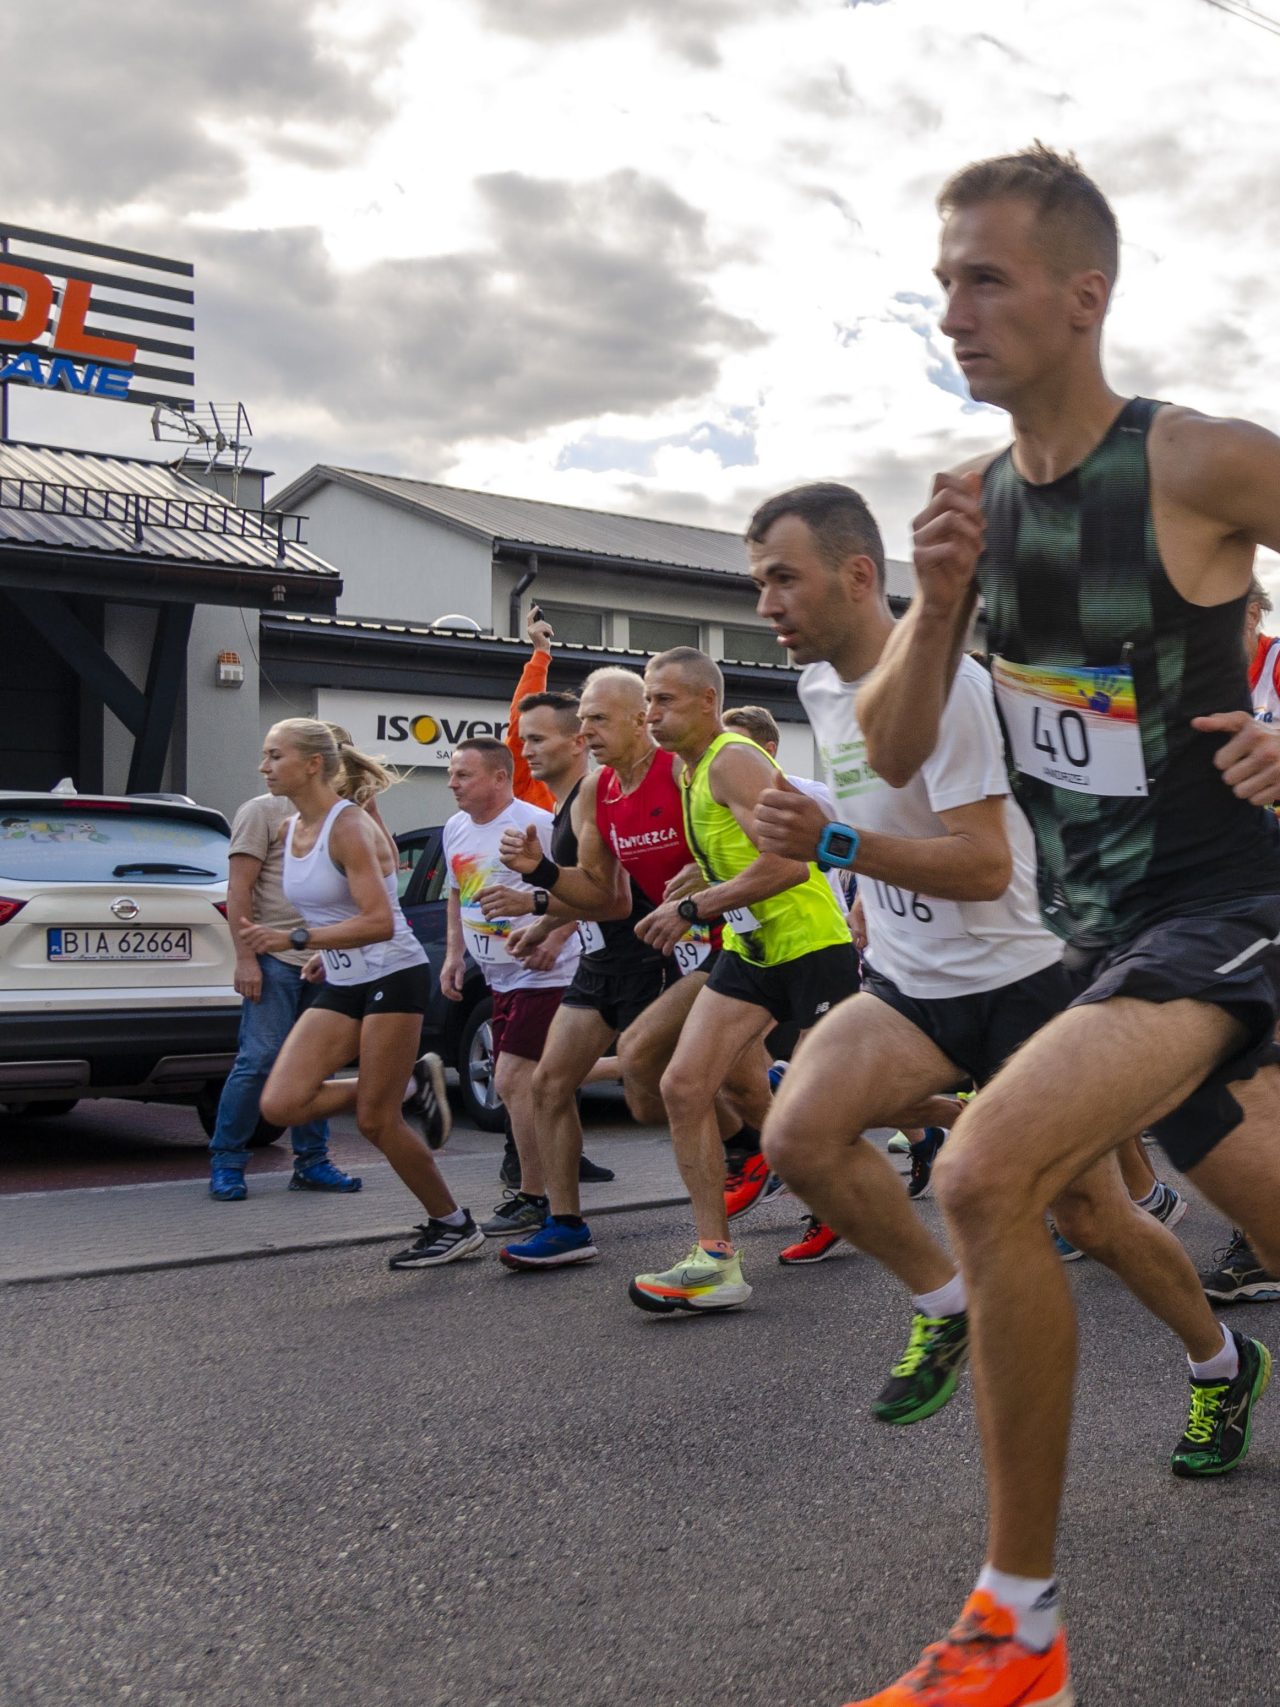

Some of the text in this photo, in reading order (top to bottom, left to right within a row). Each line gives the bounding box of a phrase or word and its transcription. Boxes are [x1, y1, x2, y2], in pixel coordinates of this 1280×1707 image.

[0, 351, 134, 400] ANE
[1033, 706, 1090, 768] 40
[618, 827, 679, 850] ZWYCIĘZCA
[874, 880, 933, 923] 106
[64, 932, 187, 954] BIA 62664
[473, 933, 490, 955] 17
[675, 943, 699, 968] 39
